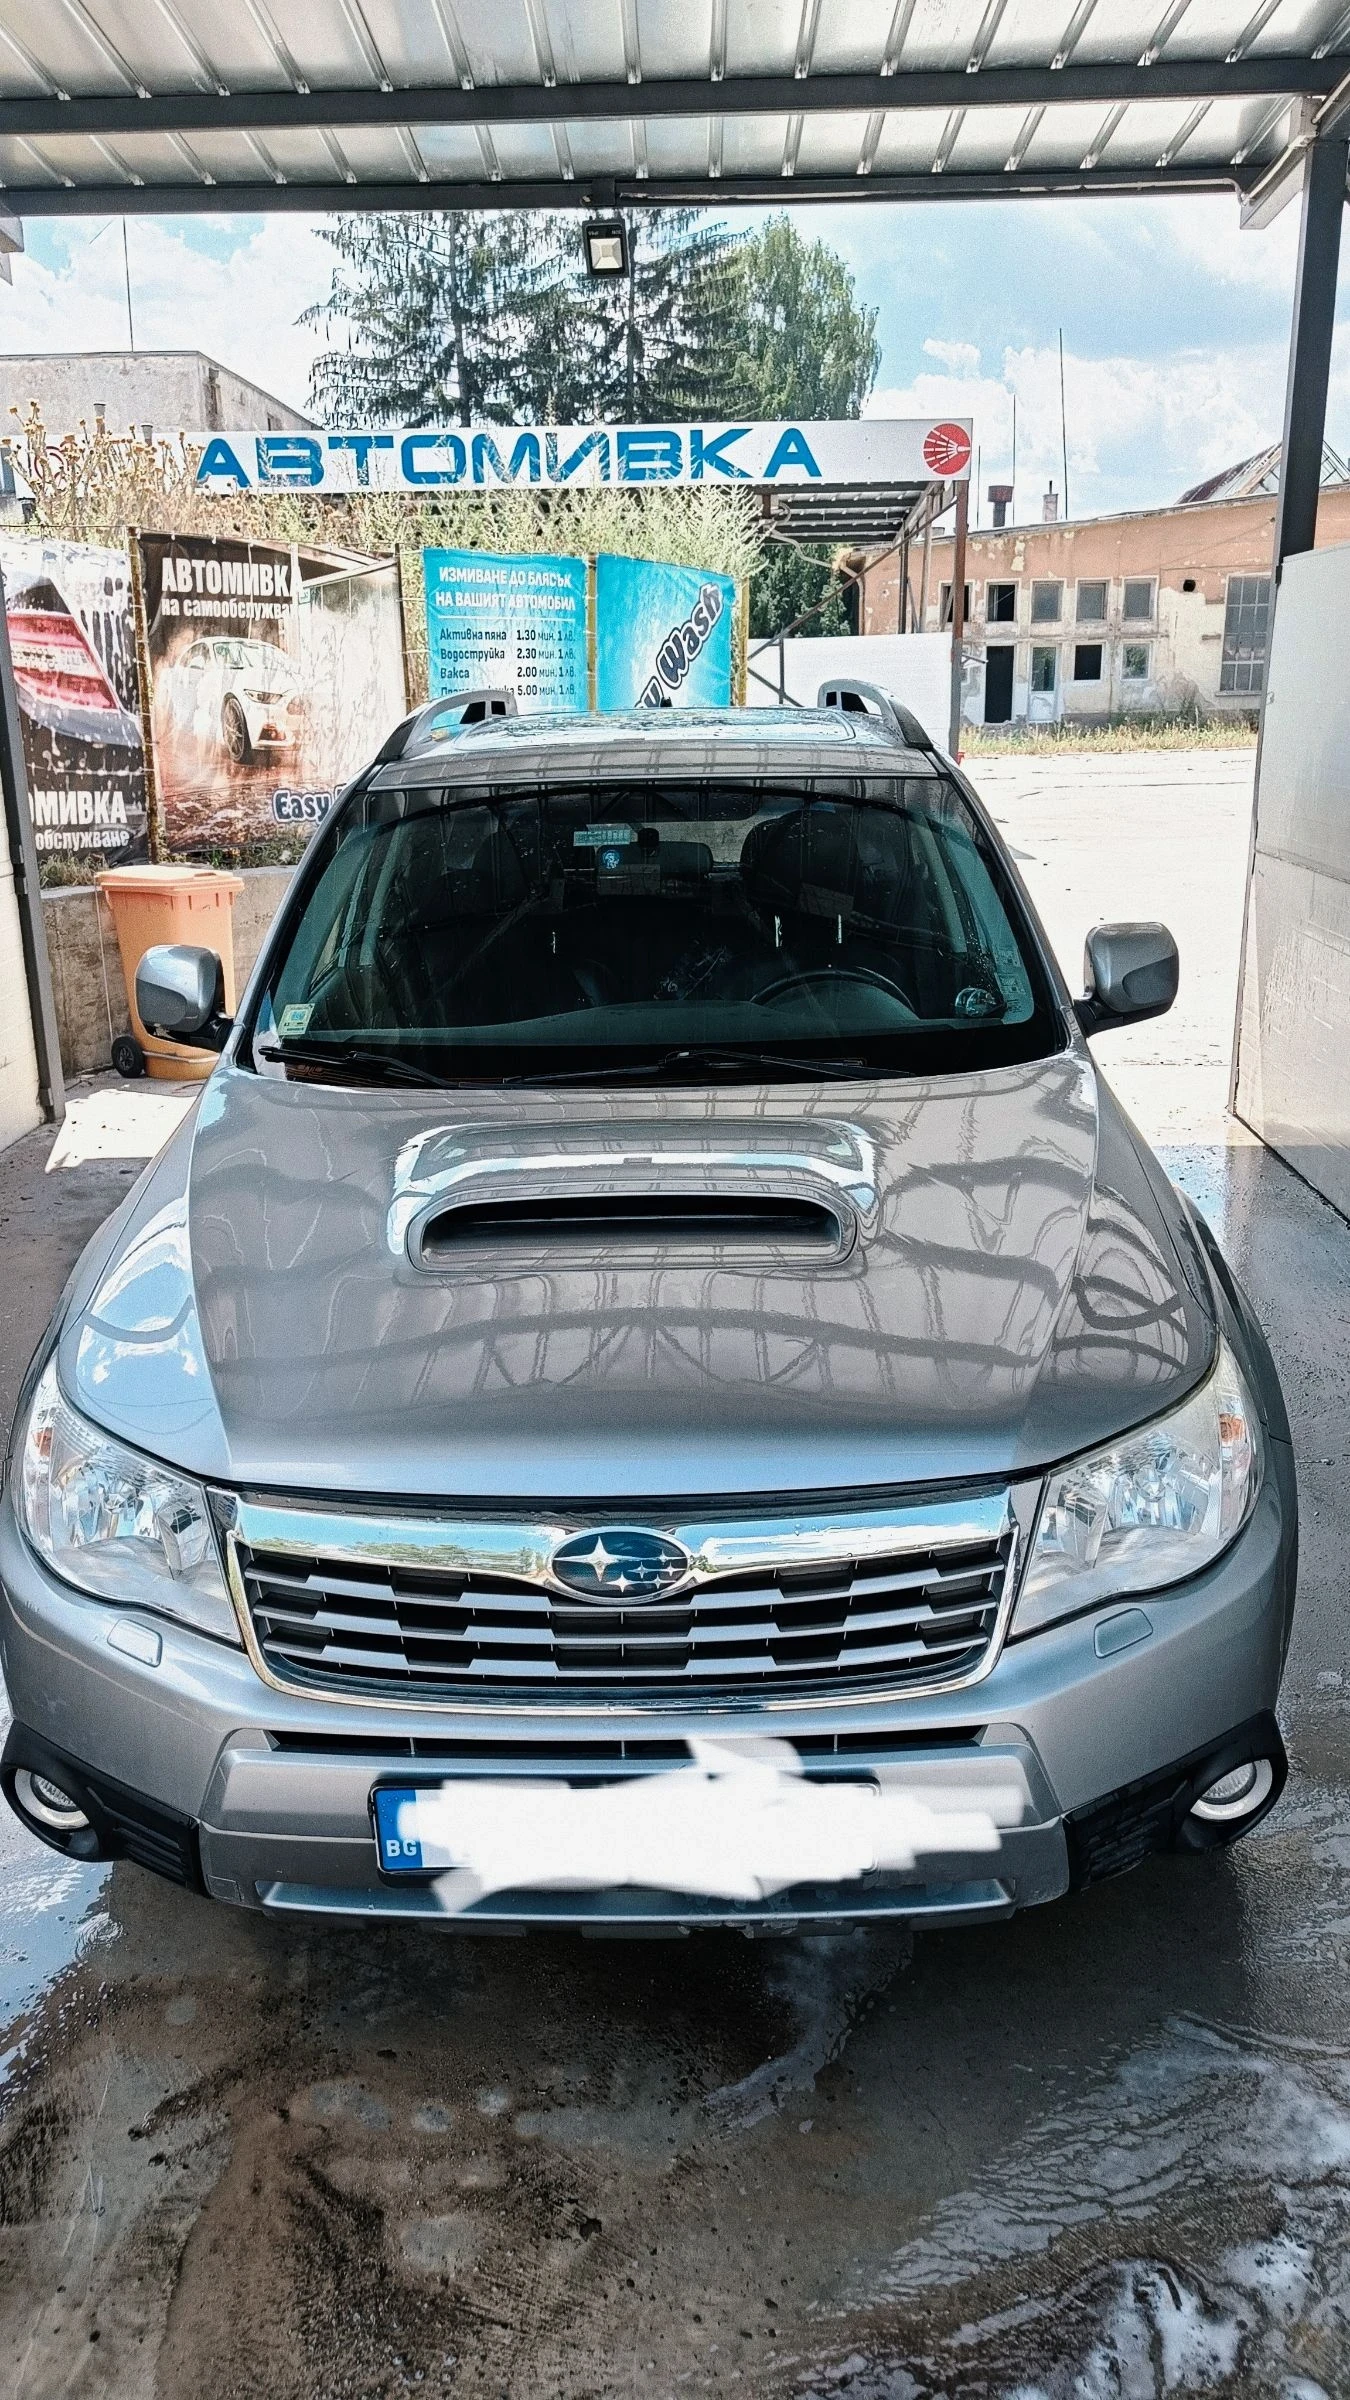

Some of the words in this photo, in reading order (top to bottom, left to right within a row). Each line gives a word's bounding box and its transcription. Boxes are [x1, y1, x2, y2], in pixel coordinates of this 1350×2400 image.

[195, 428, 822, 488] АВТОМИВКА
[161, 557, 303, 598] АВТОМИВКА
[439, 566, 508, 586] ИЗМИВАНЕ
[509, 571, 526, 588] ДО
[527, 572, 573, 589] БЛЯСЪК
[161, 597, 180, 616] на
[183, 598, 294, 621] самообслужва
[435, 591, 453, 607] НА
[455, 592, 506, 609] ВАШИЯТ
[508, 594, 576, 611] АВТОМОБИЛ
[440, 628, 483, 641] Активна
[484, 630, 507, 641] пяна
[516, 629, 536, 641] 1.30
[557, 629, 563, 641] 1
[657, 584, 722, 688] Wash
[441, 648, 505, 662] Водоструйка
[517, 648, 537, 659] 2.30
[558, 648, 564, 659] 1
[440, 667, 470, 679] Вакса
[517, 667, 537, 678] 2.00
[558, 667, 564, 678] 1
[517, 685, 538, 696] 5.00
[559, 685, 565, 696] 1
[28, 790, 128, 826] МИВКА
[273, 789, 331, 823] Easy
[386, 1839, 417, 1857] BG
